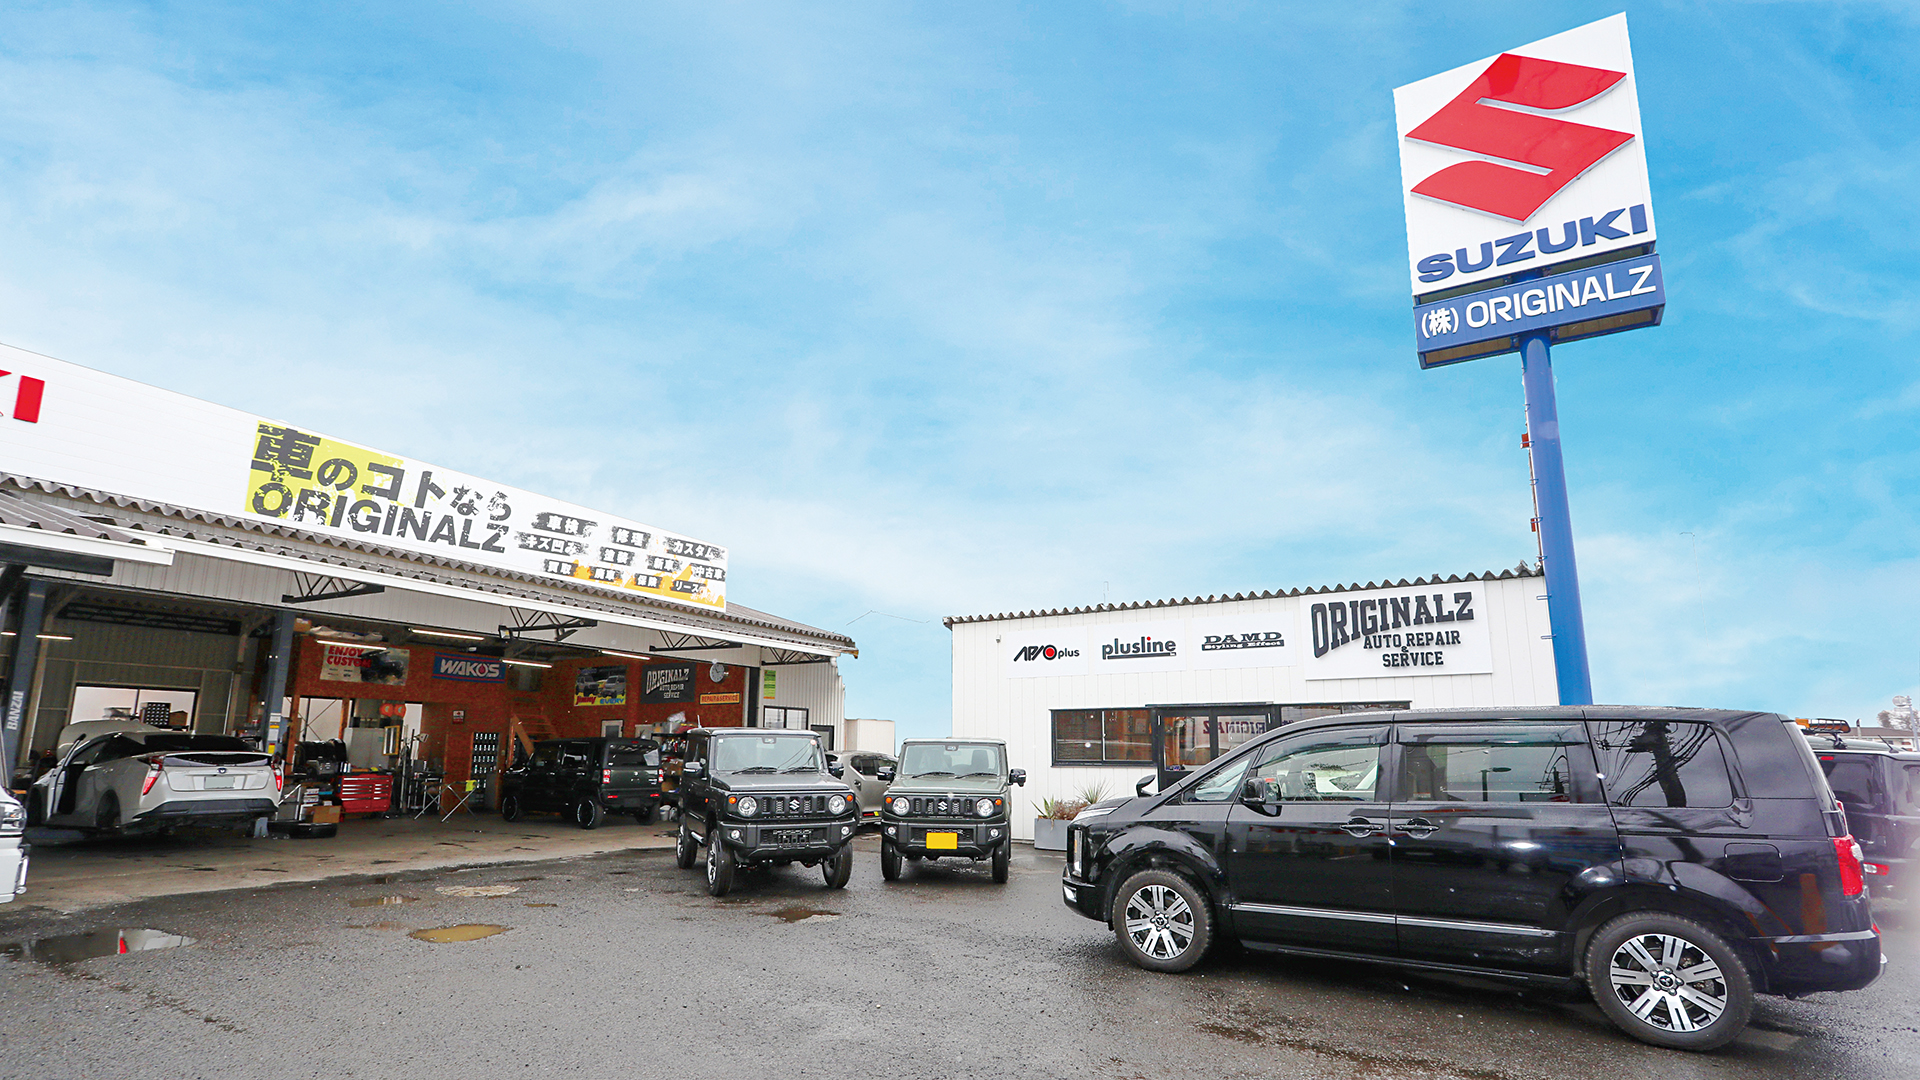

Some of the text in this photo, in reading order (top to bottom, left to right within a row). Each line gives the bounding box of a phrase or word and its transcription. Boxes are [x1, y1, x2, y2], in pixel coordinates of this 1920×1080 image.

[1417, 204, 1648, 283] SUZUKI
[1421, 265, 1656, 338] (株) ORIGINALZ
[251, 424, 511, 521] 車のコトなら
[252, 482, 509, 553] ORIGINALZ
[547, 515, 579, 535] 車検
[525, 534, 581, 555] キズ凹み
[616, 528, 644, 547] 修理
[673, 541, 715, 559] カスタム
[695, 565, 724, 580] 中古車
[675, 580, 700, 593] リース
[1311, 592, 1474, 658] ORIGINALZ
[1204, 632, 1282, 644] DAMD
[1363, 630, 1461, 649] AUTO REPAIR
[328, 646, 364, 657] ENJOY
[1058, 647, 1080, 659] plus
[1102, 636, 1176, 660] plusline
[326, 655, 372, 668] CUSTOM
[1382, 651, 1443, 667] SERVICE
[646, 668, 690, 694] ORIGINALZ
[6, 690, 24, 730] BANZAI
